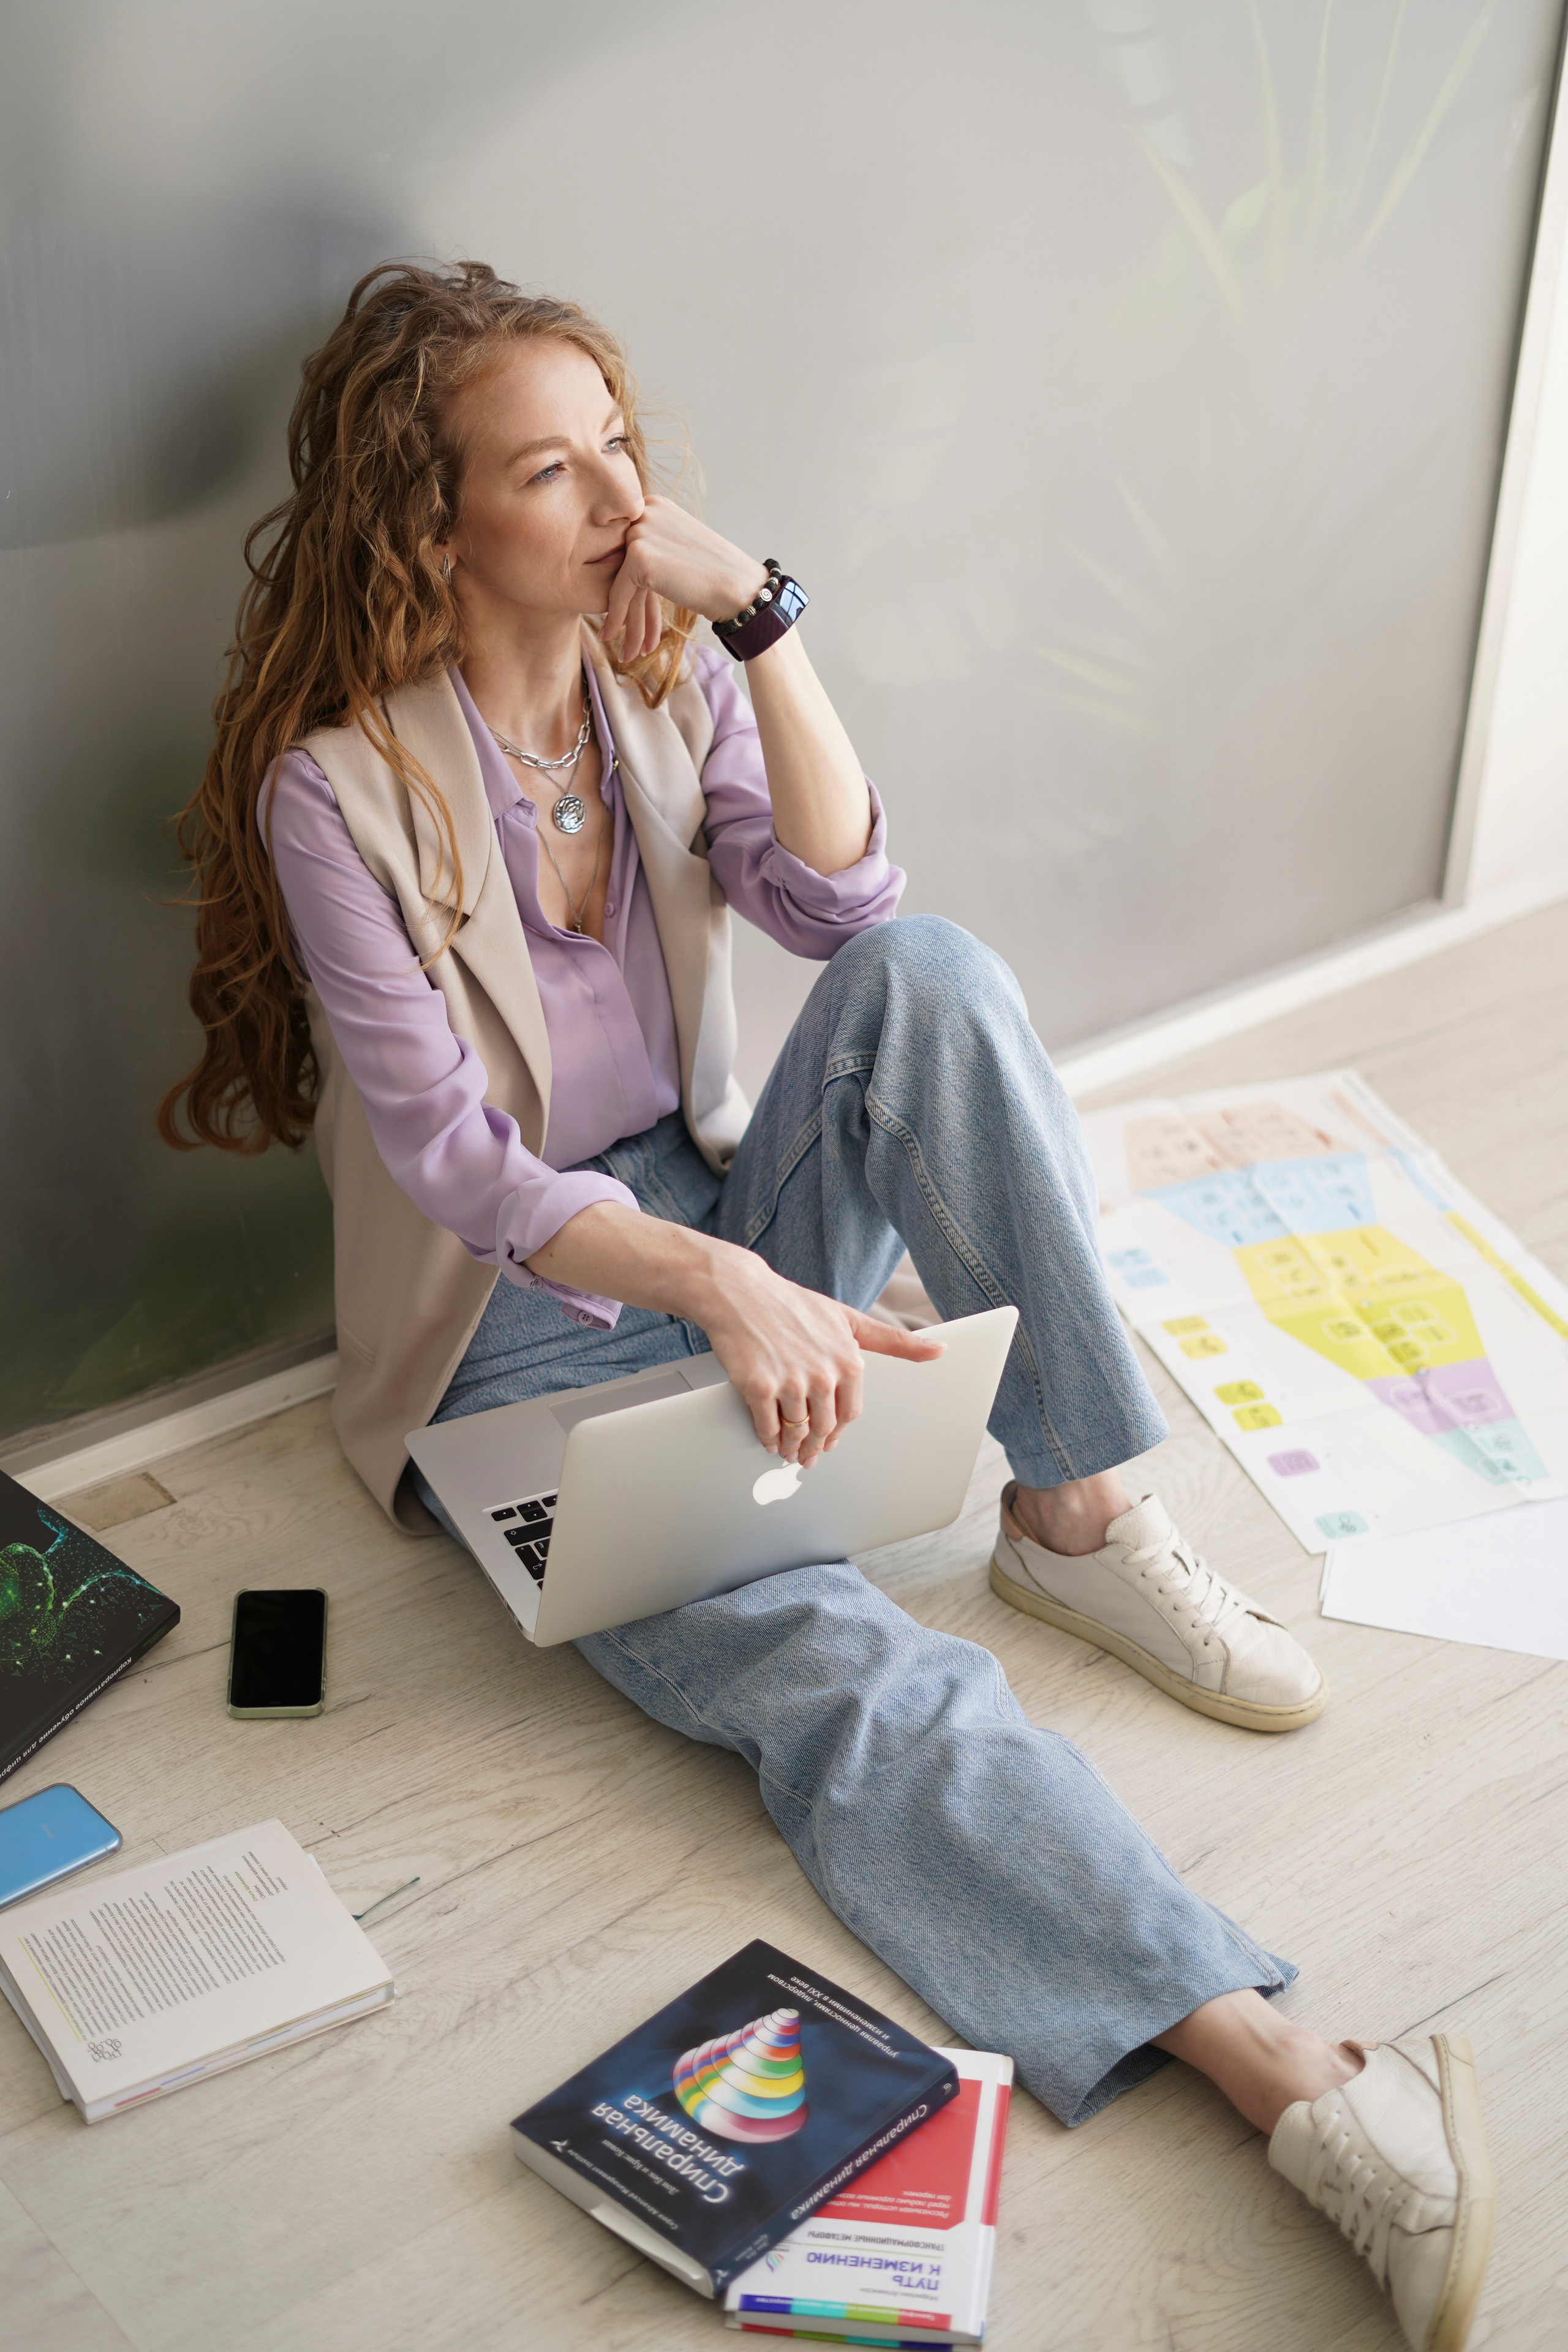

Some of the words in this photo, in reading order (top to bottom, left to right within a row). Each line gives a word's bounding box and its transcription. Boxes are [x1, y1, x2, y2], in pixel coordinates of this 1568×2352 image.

[75, 1657, 132, 1709] Корпоративное
[39, 1709, 74, 1743] обучение
[23, 1741, 37, 1757] для
[767, 1973, 813, 2002] лидерством
[790, 1976, 810, 1989] веке
[807, 1987, 824, 1999] XXI
[814, 2000, 861, 2032] ценностями,
[828, 1999, 883, 2035] изменениями
[860, 2030, 899, 2057] управляя
[624, 2095, 744, 2176] динамика
[855, 2105, 927, 2167] Спиральная
[593, 2103, 728, 2203] Спиральная
[601, 2139, 625, 2157] Кован
[567, 2149, 594, 2168] Institute
[623, 2154, 643, 2170] Крис
[592, 2166, 630, 2195] Management
[648, 2171, 663, 2185] Бек
[661, 2181, 679, 2195] Дон
[791, 2162, 853, 2220] динамика
[628, 2192, 659, 2215] Advanced
[856, 2194, 895, 2203] огромные
[896, 2198, 927, 2206] людьми
[899, 2207, 949, 2218] Рассказывая
[808, 2231, 851, 2241] МЕТАФОРЫ
[854, 2235, 943, 2251] ТРАНСФОРМАЦИОННЫЕ
[807, 2252, 922, 2272] ИЗМЕНЕНИЮ
[929, 2264, 941, 2275] К
[892, 2275, 939, 2291] ПУТЬ
